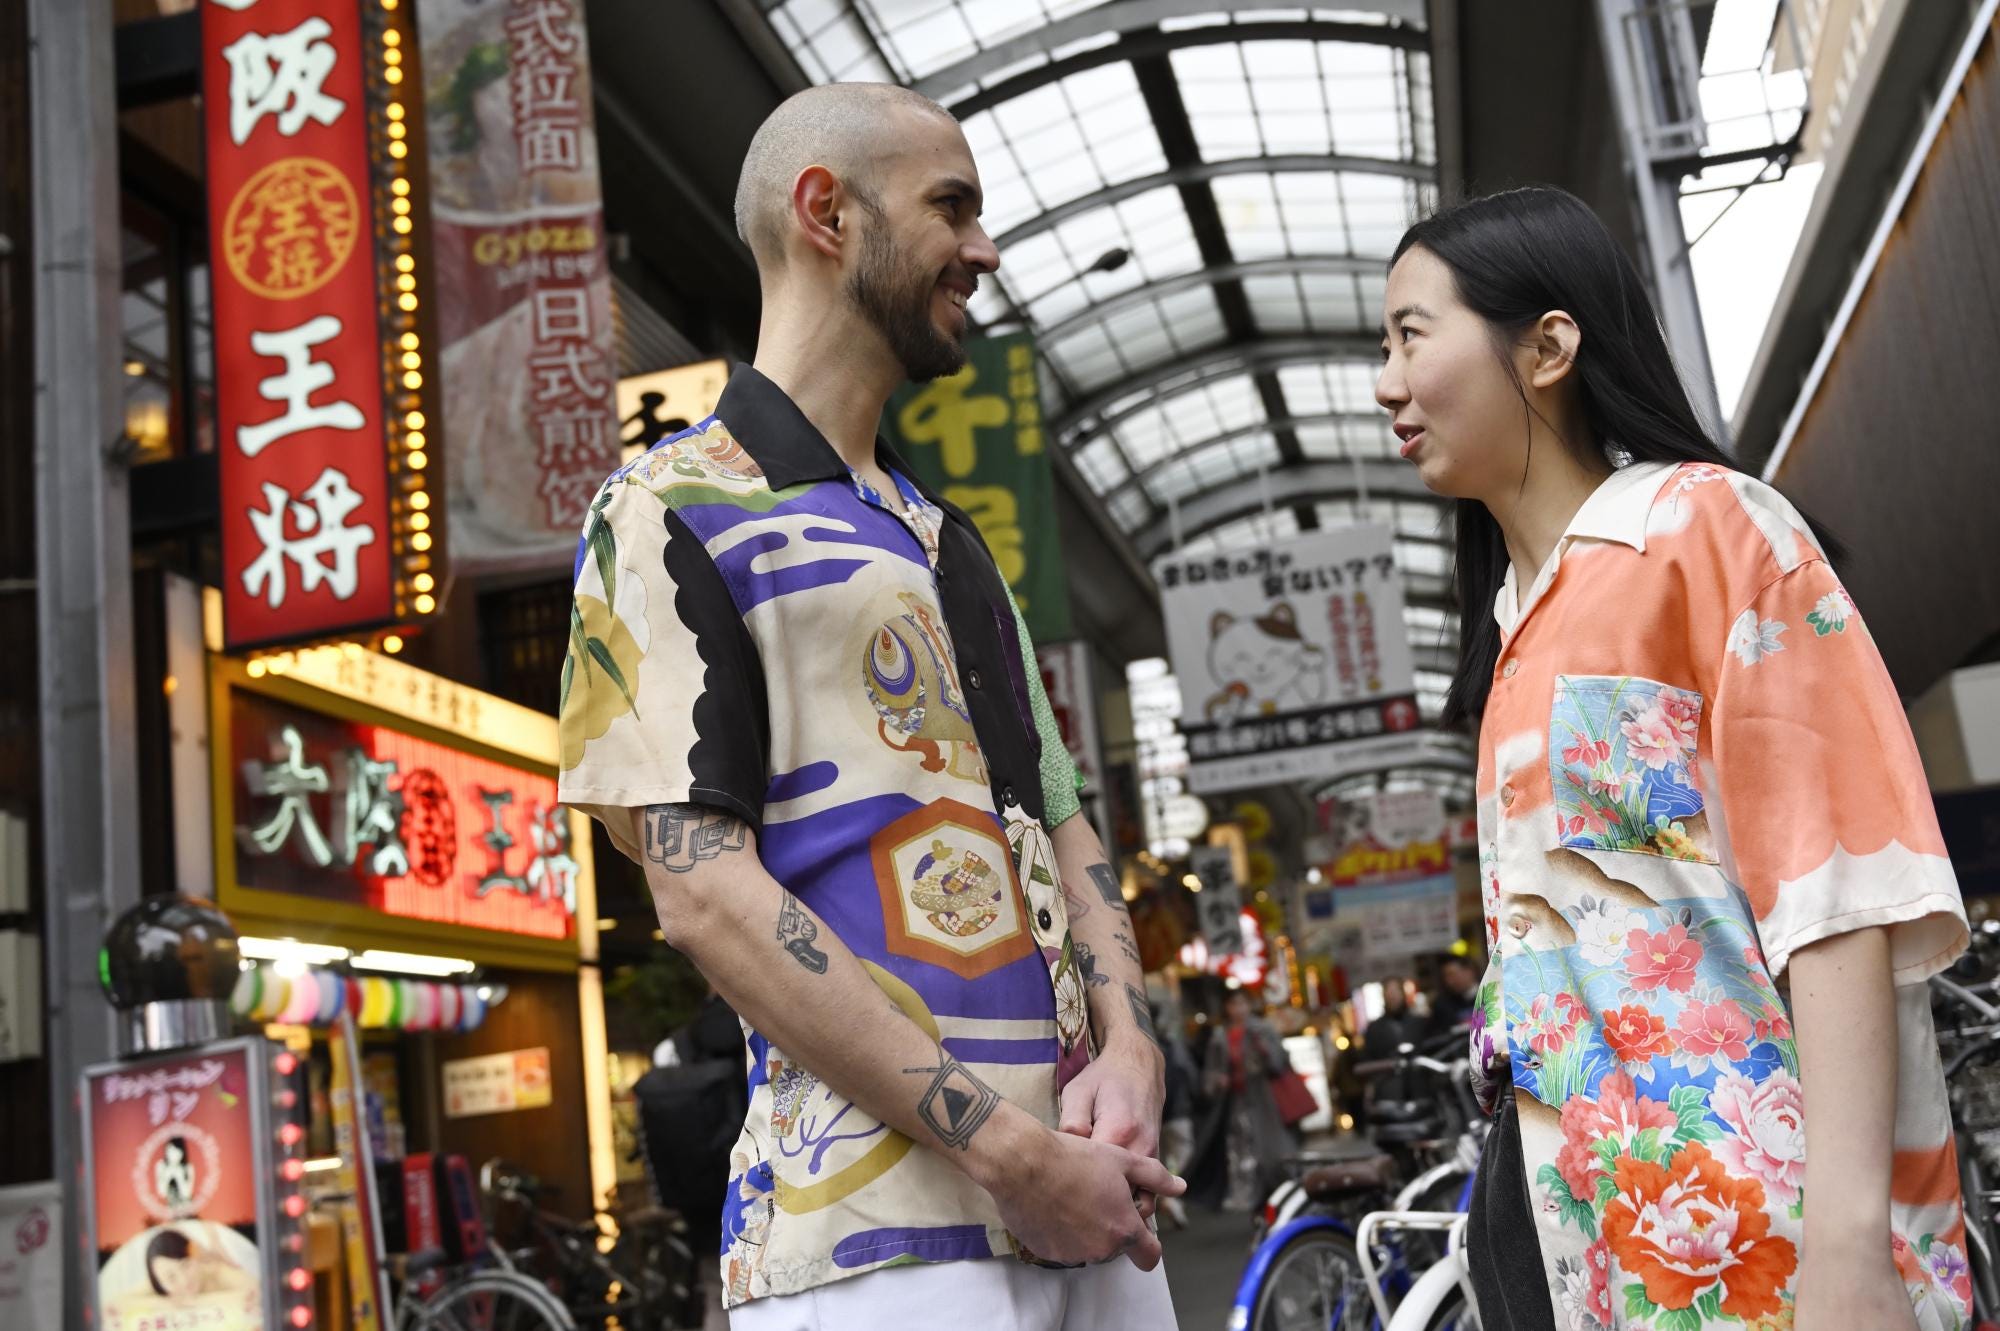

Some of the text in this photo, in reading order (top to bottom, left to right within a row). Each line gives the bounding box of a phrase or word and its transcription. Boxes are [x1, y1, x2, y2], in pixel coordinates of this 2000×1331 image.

[203, 0, 376, 609] 阪 王将
[474, 225, 597, 268] Gyoza
